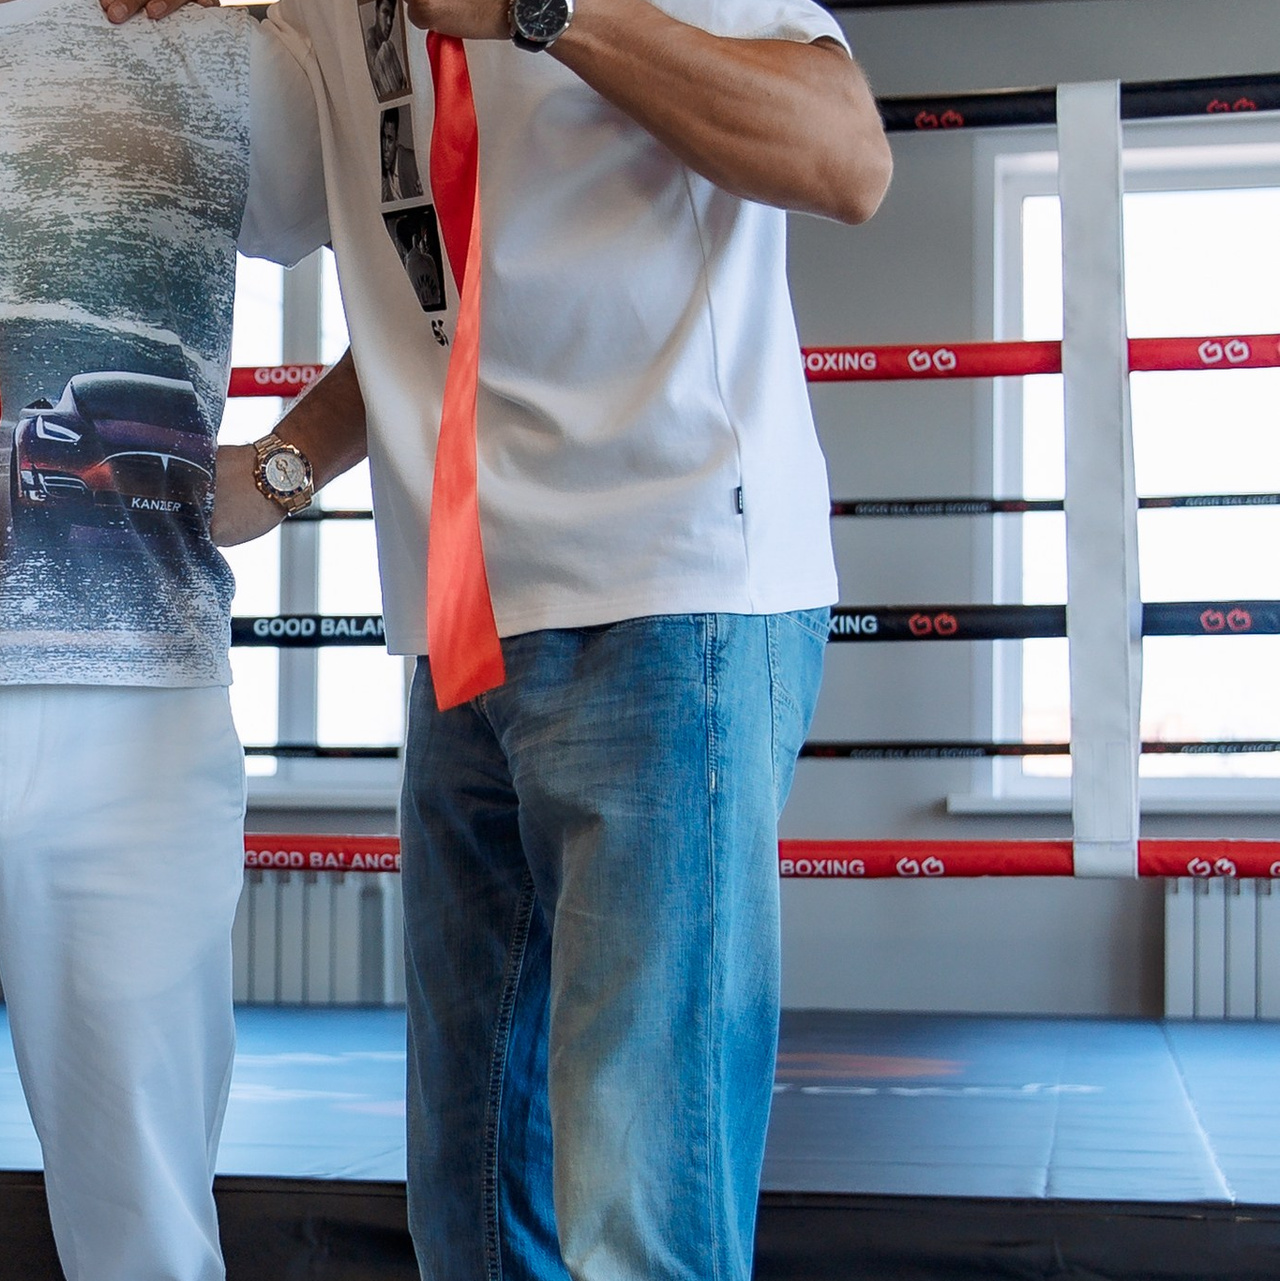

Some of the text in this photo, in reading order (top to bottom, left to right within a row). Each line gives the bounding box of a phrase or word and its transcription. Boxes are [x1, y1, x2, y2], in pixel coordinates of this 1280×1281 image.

[253, 366, 317, 385] GOOD
[253, 618, 317, 637] GOOD
[829, 614, 878, 635] XING
[245, 850, 304, 867] GOOD
[780, 859, 865, 876] BOXING
